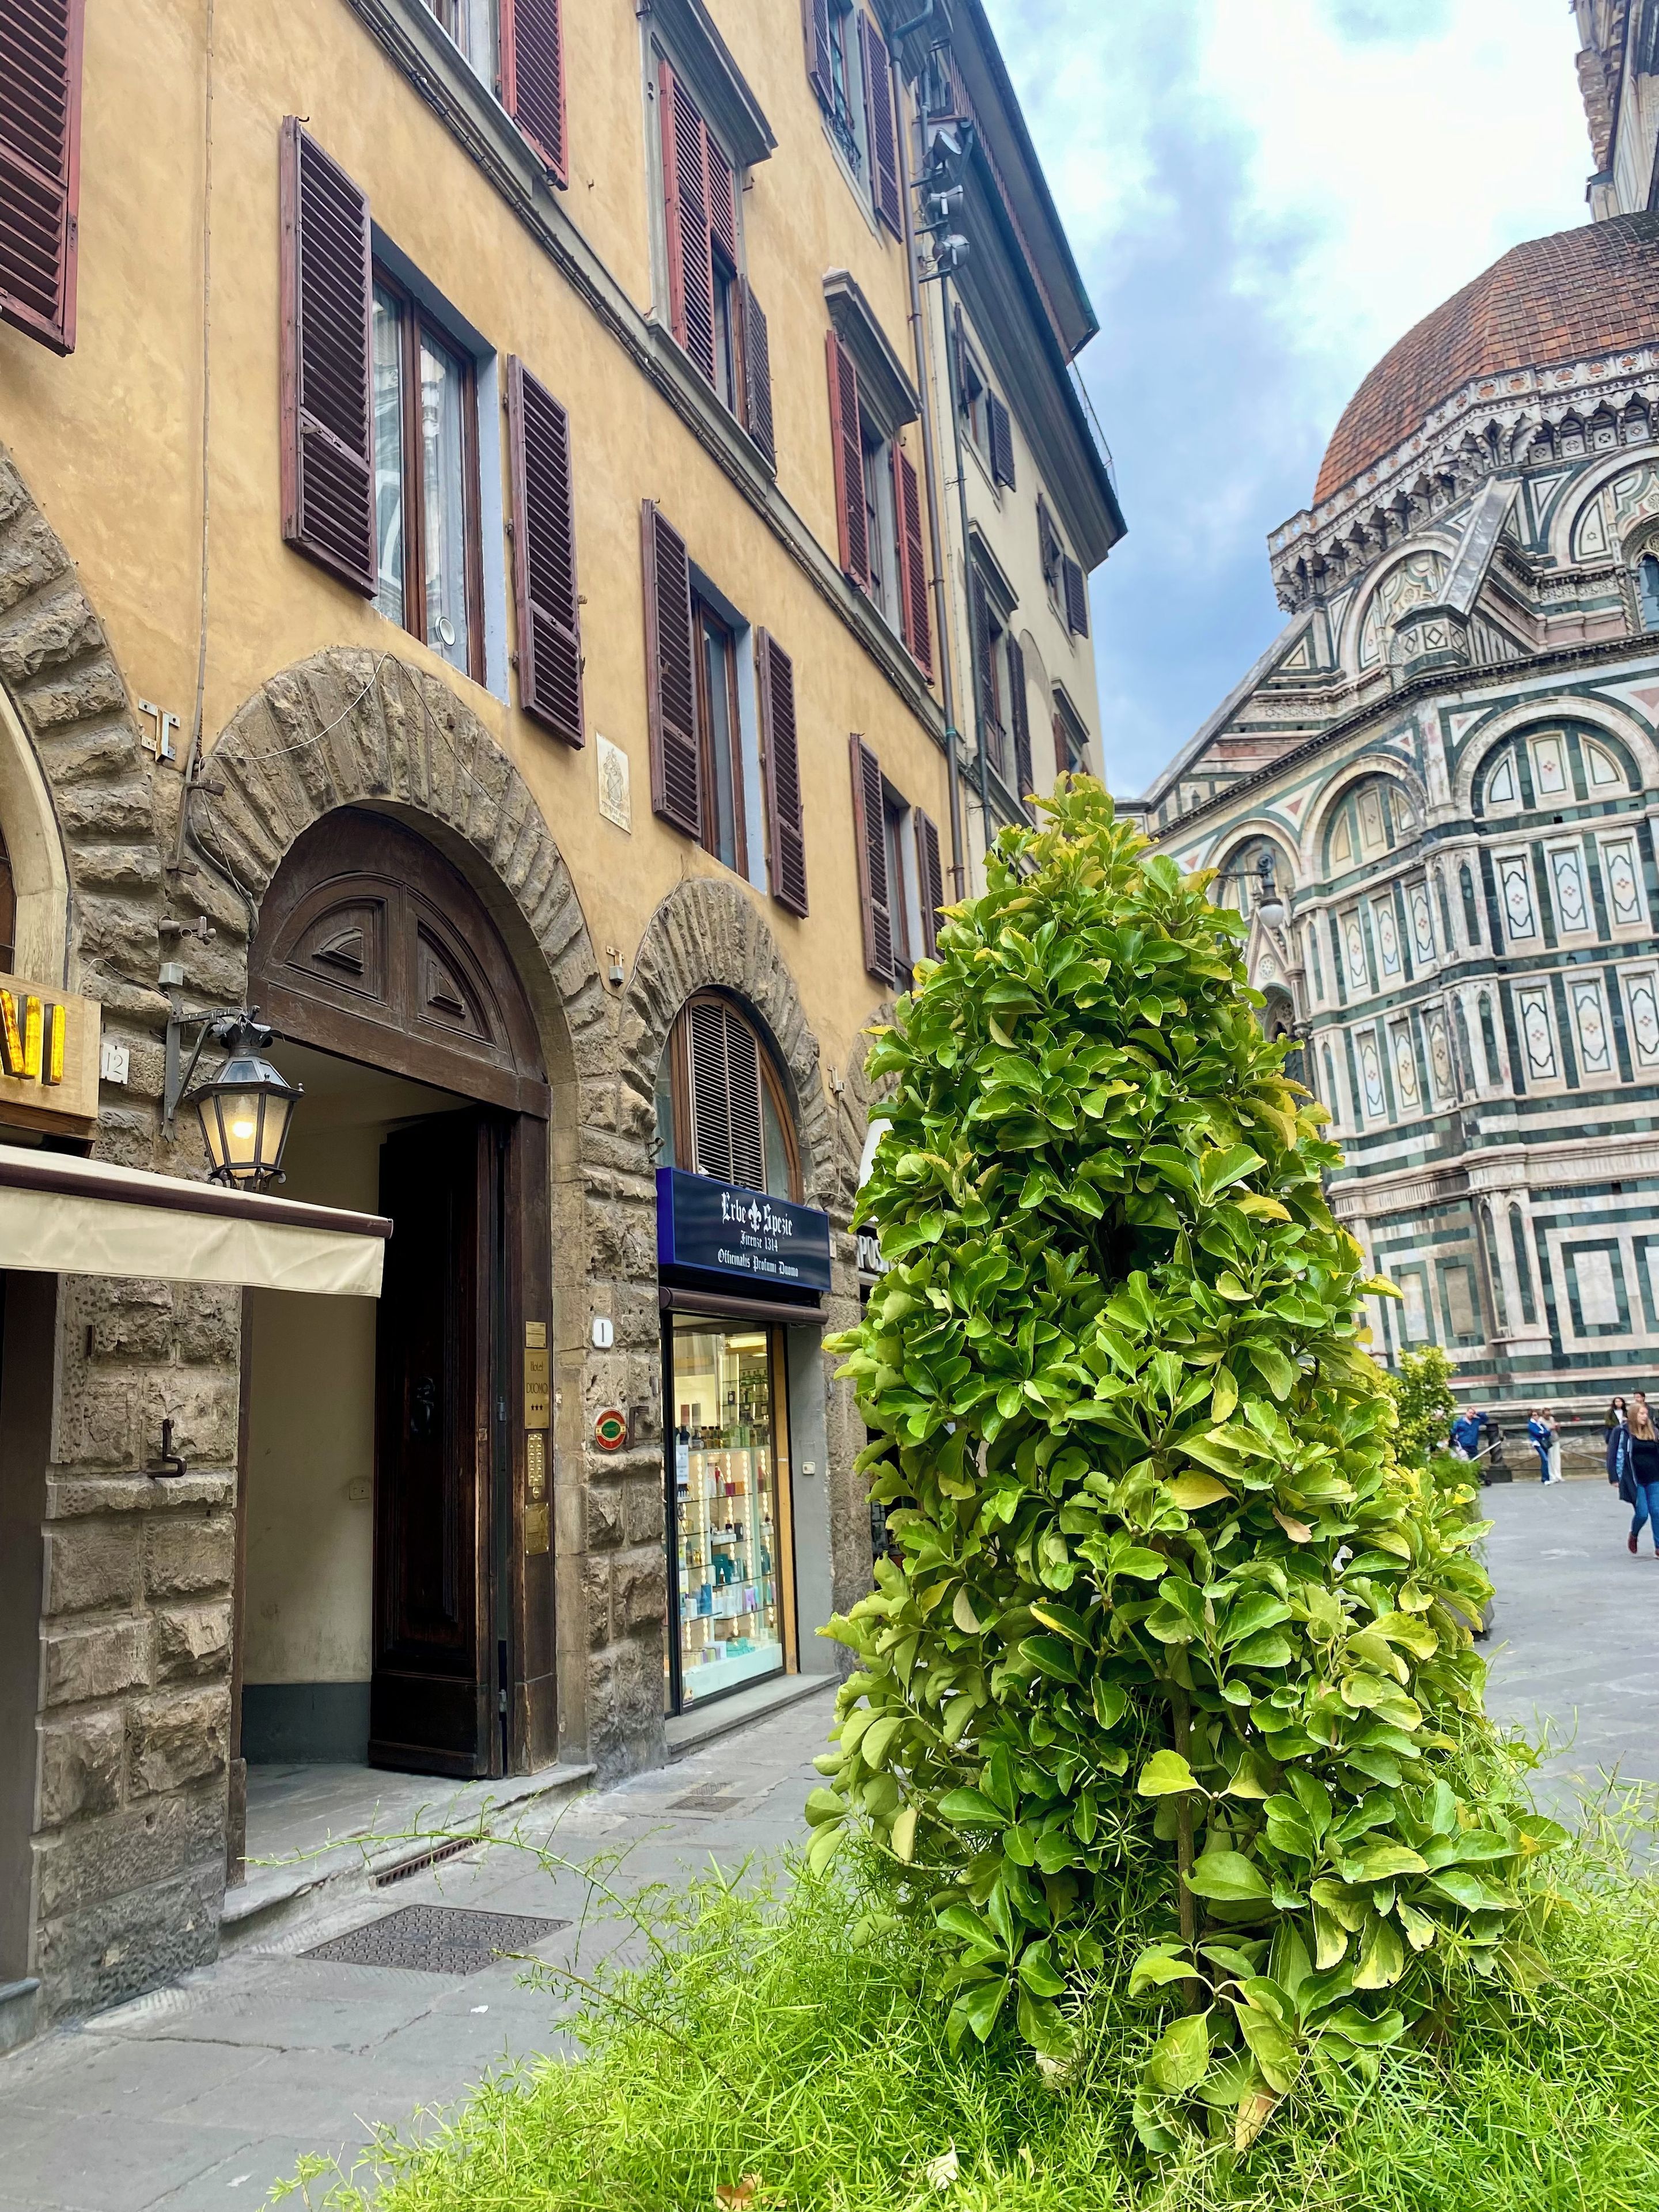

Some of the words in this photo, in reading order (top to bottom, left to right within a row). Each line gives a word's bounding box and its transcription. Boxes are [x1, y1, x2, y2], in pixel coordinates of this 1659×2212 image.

[108, 1052, 124, 1076] 12
[721, 1191, 747, 1224] Erbe
[762, 1203, 793, 1239] Spezie
[740, 1229, 763, 1251] Firenze
[764, 1236, 779, 1252] 1314
[718, 1248, 751, 1268] Officinalis
[752, 1255, 777, 1274] Profumi
[778, 1260, 799, 1277] Duomo
[530, 1361, 544, 1372] Hotel
[526, 1382, 548, 1394] DUOMO
